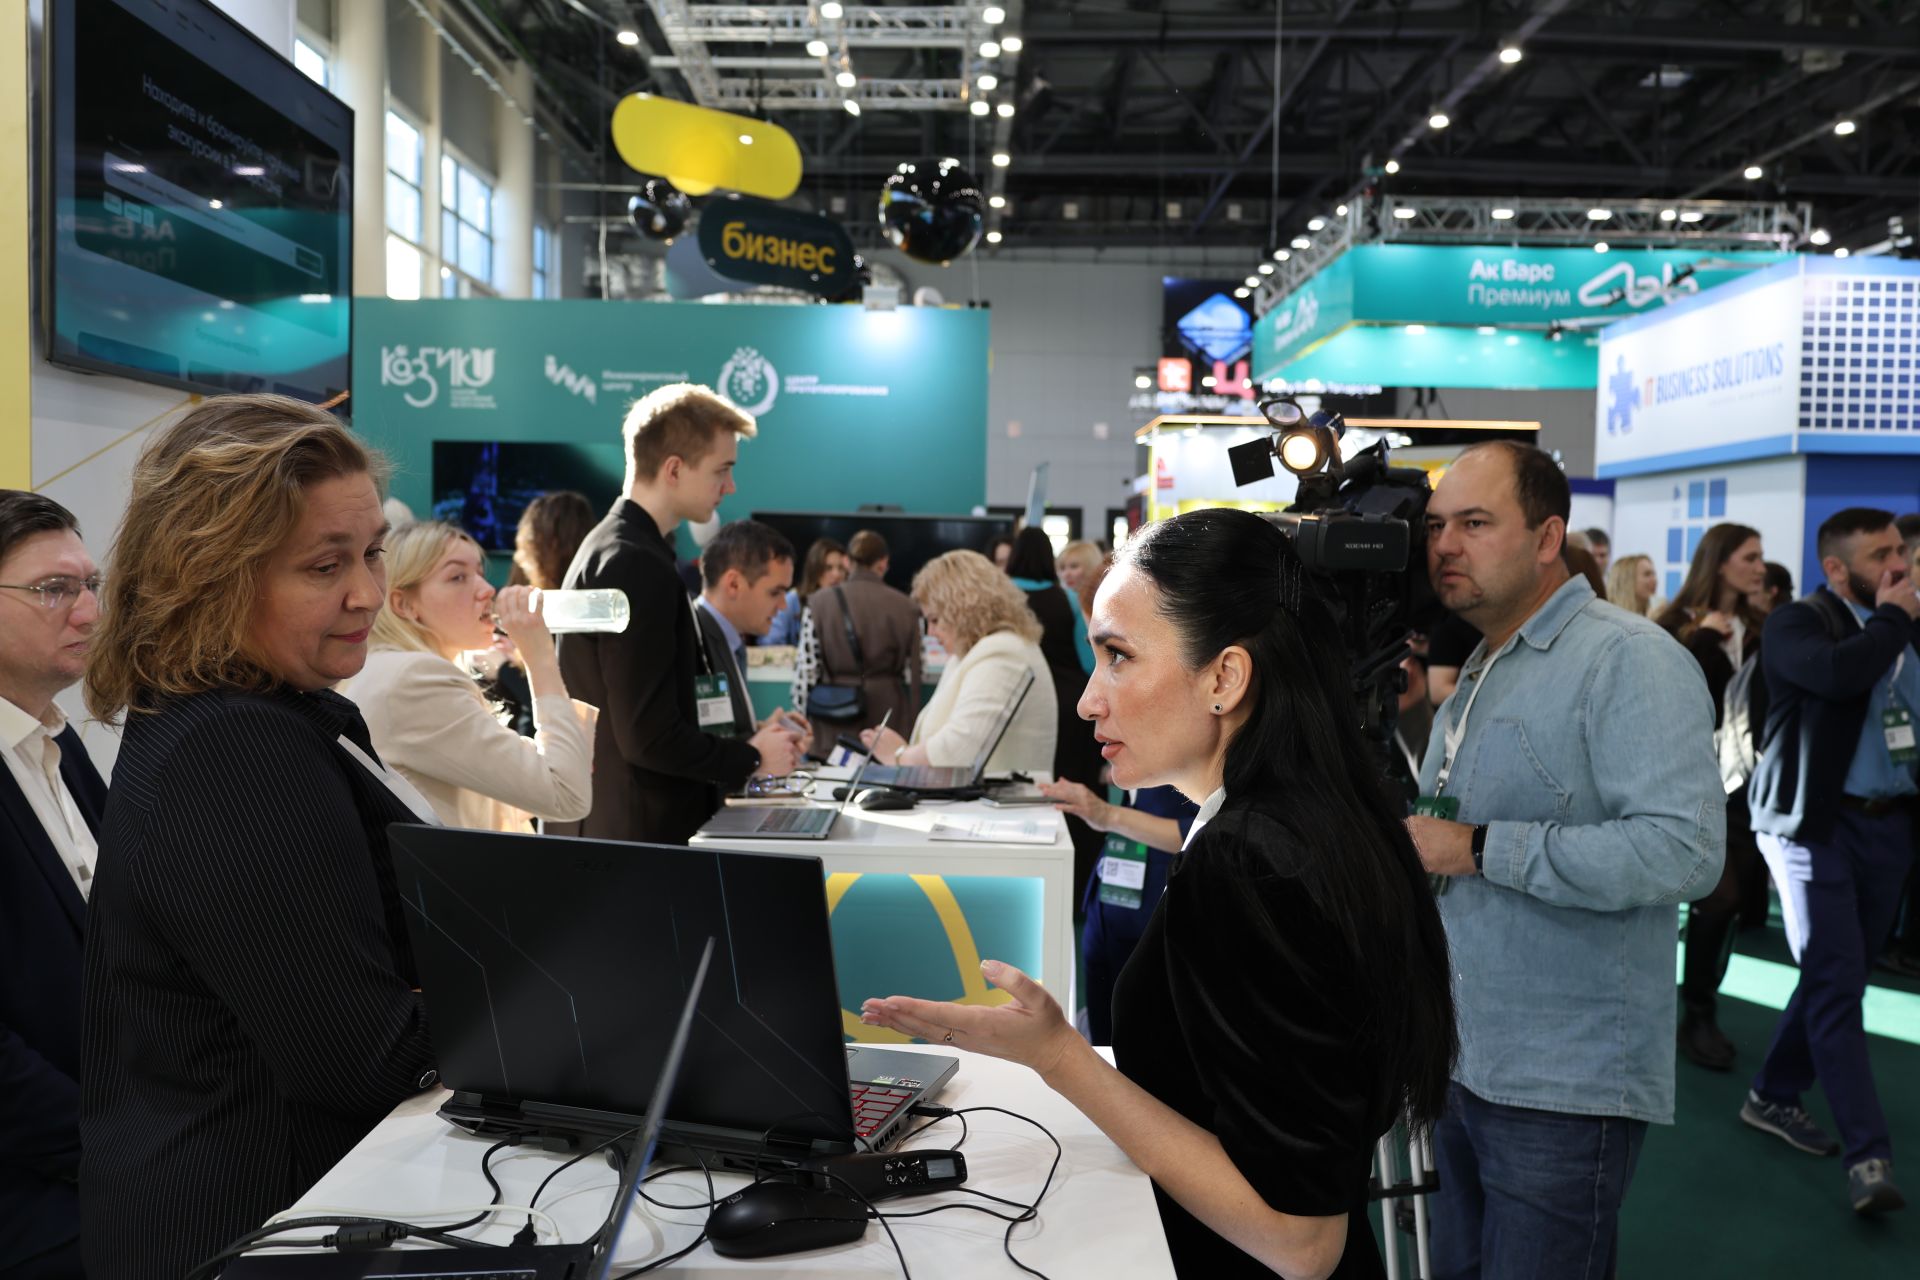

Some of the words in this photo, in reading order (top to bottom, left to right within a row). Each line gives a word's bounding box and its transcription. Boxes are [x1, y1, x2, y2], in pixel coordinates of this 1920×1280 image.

[142, 73, 197, 123] Находите
[721, 221, 836, 275] бизнес
[1469, 258, 1499, 281] Ак
[1502, 258, 1556, 283] Барс
[1467, 283, 1571, 310] Премиум
[1656, 361, 1710, 406] BUSINESS
[1712, 341, 1785, 392] SOLUTIONS
